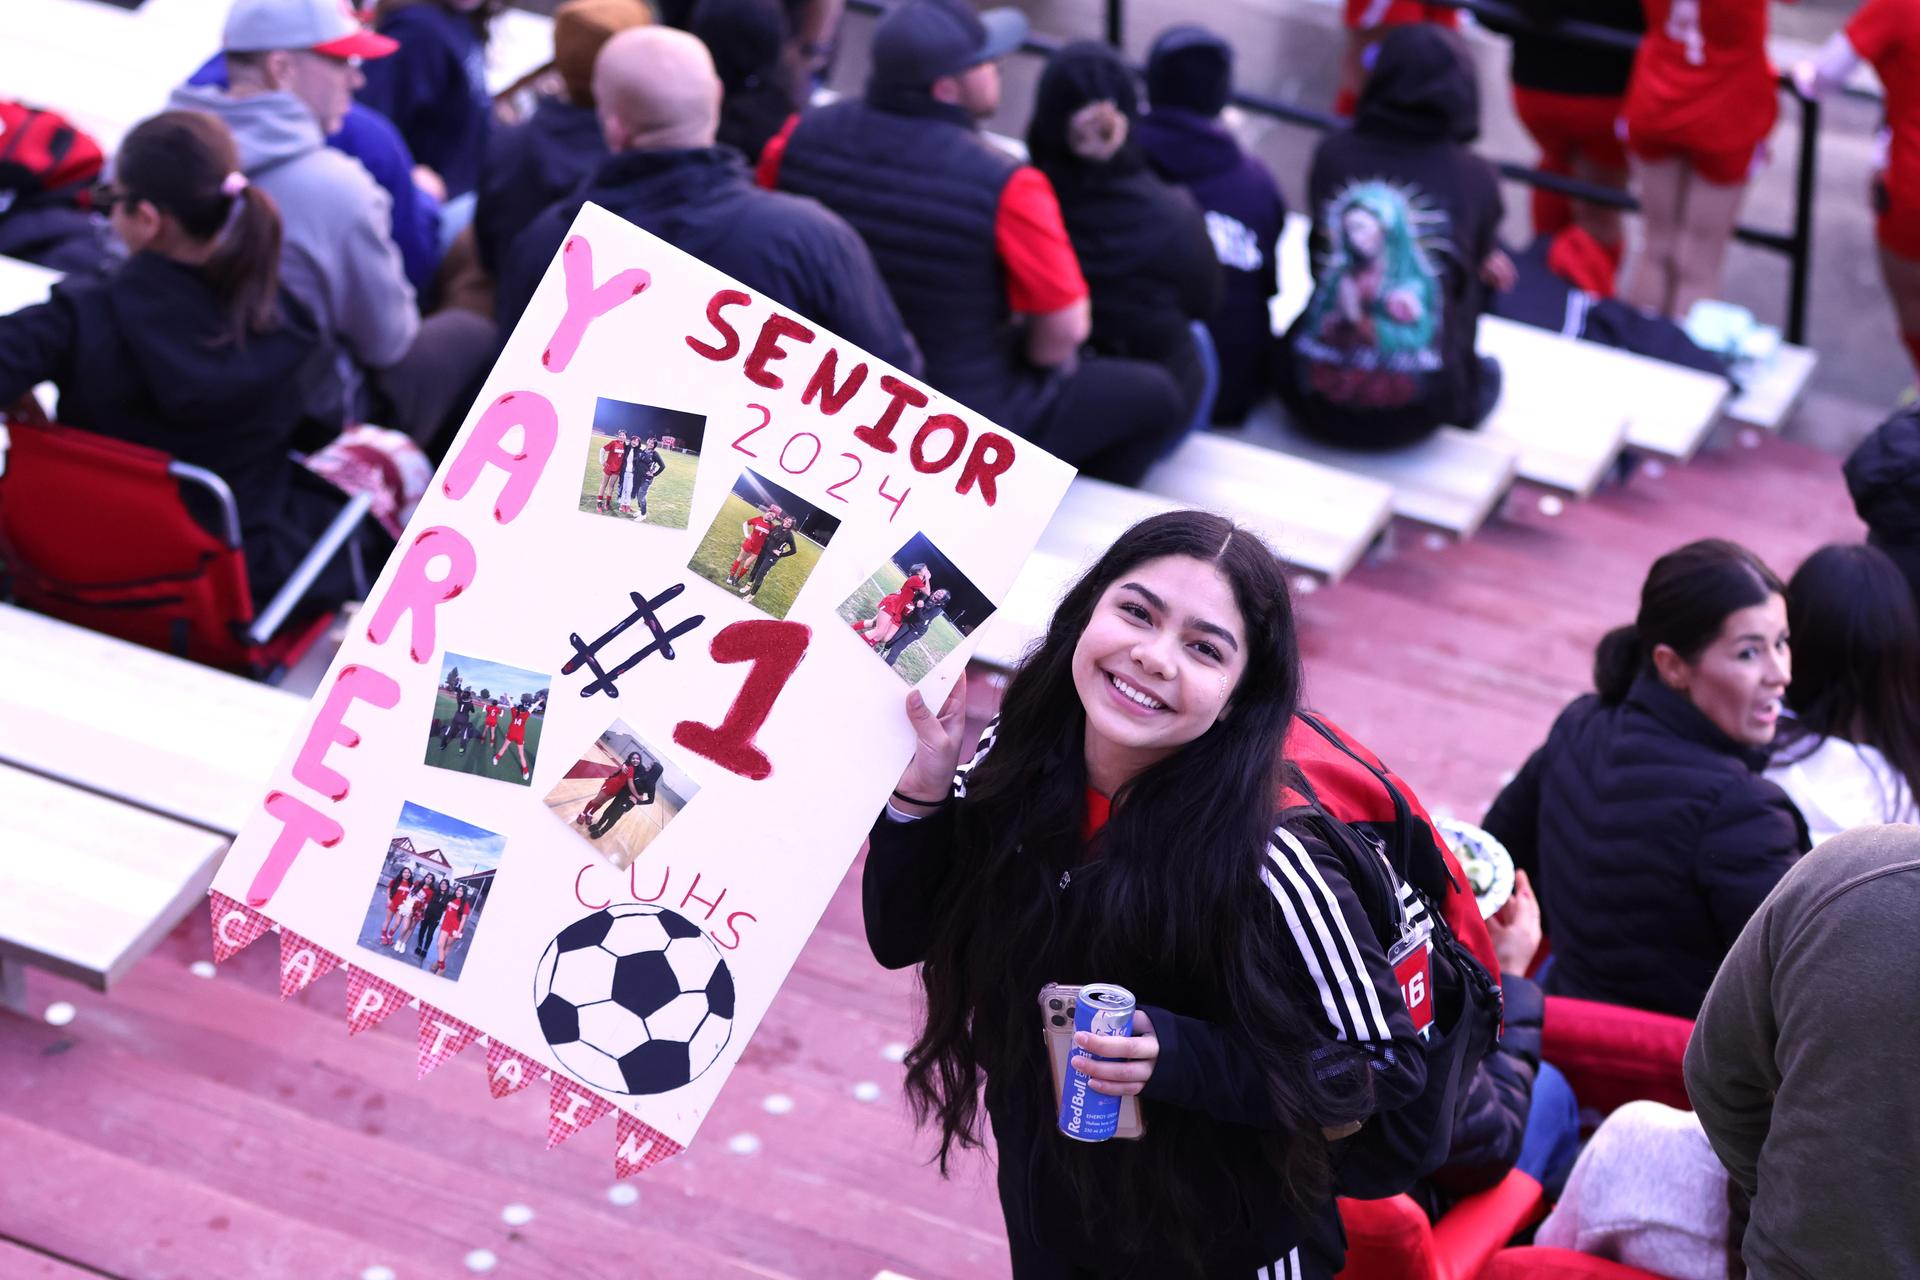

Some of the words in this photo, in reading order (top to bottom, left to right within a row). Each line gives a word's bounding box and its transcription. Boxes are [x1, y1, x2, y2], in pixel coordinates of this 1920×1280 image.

[685, 289, 1016, 507] SENIOR
[731, 403, 912, 524] 2024
[246, 234, 651, 908] YARET
[561, 583, 813, 781] #1
[575, 861, 757, 950] CUHS
[217, 910, 653, 1167] CAPTAIN
[1071, 1079, 1087, 1107] Bull
[1068, 1104, 1083, 1133] Red
